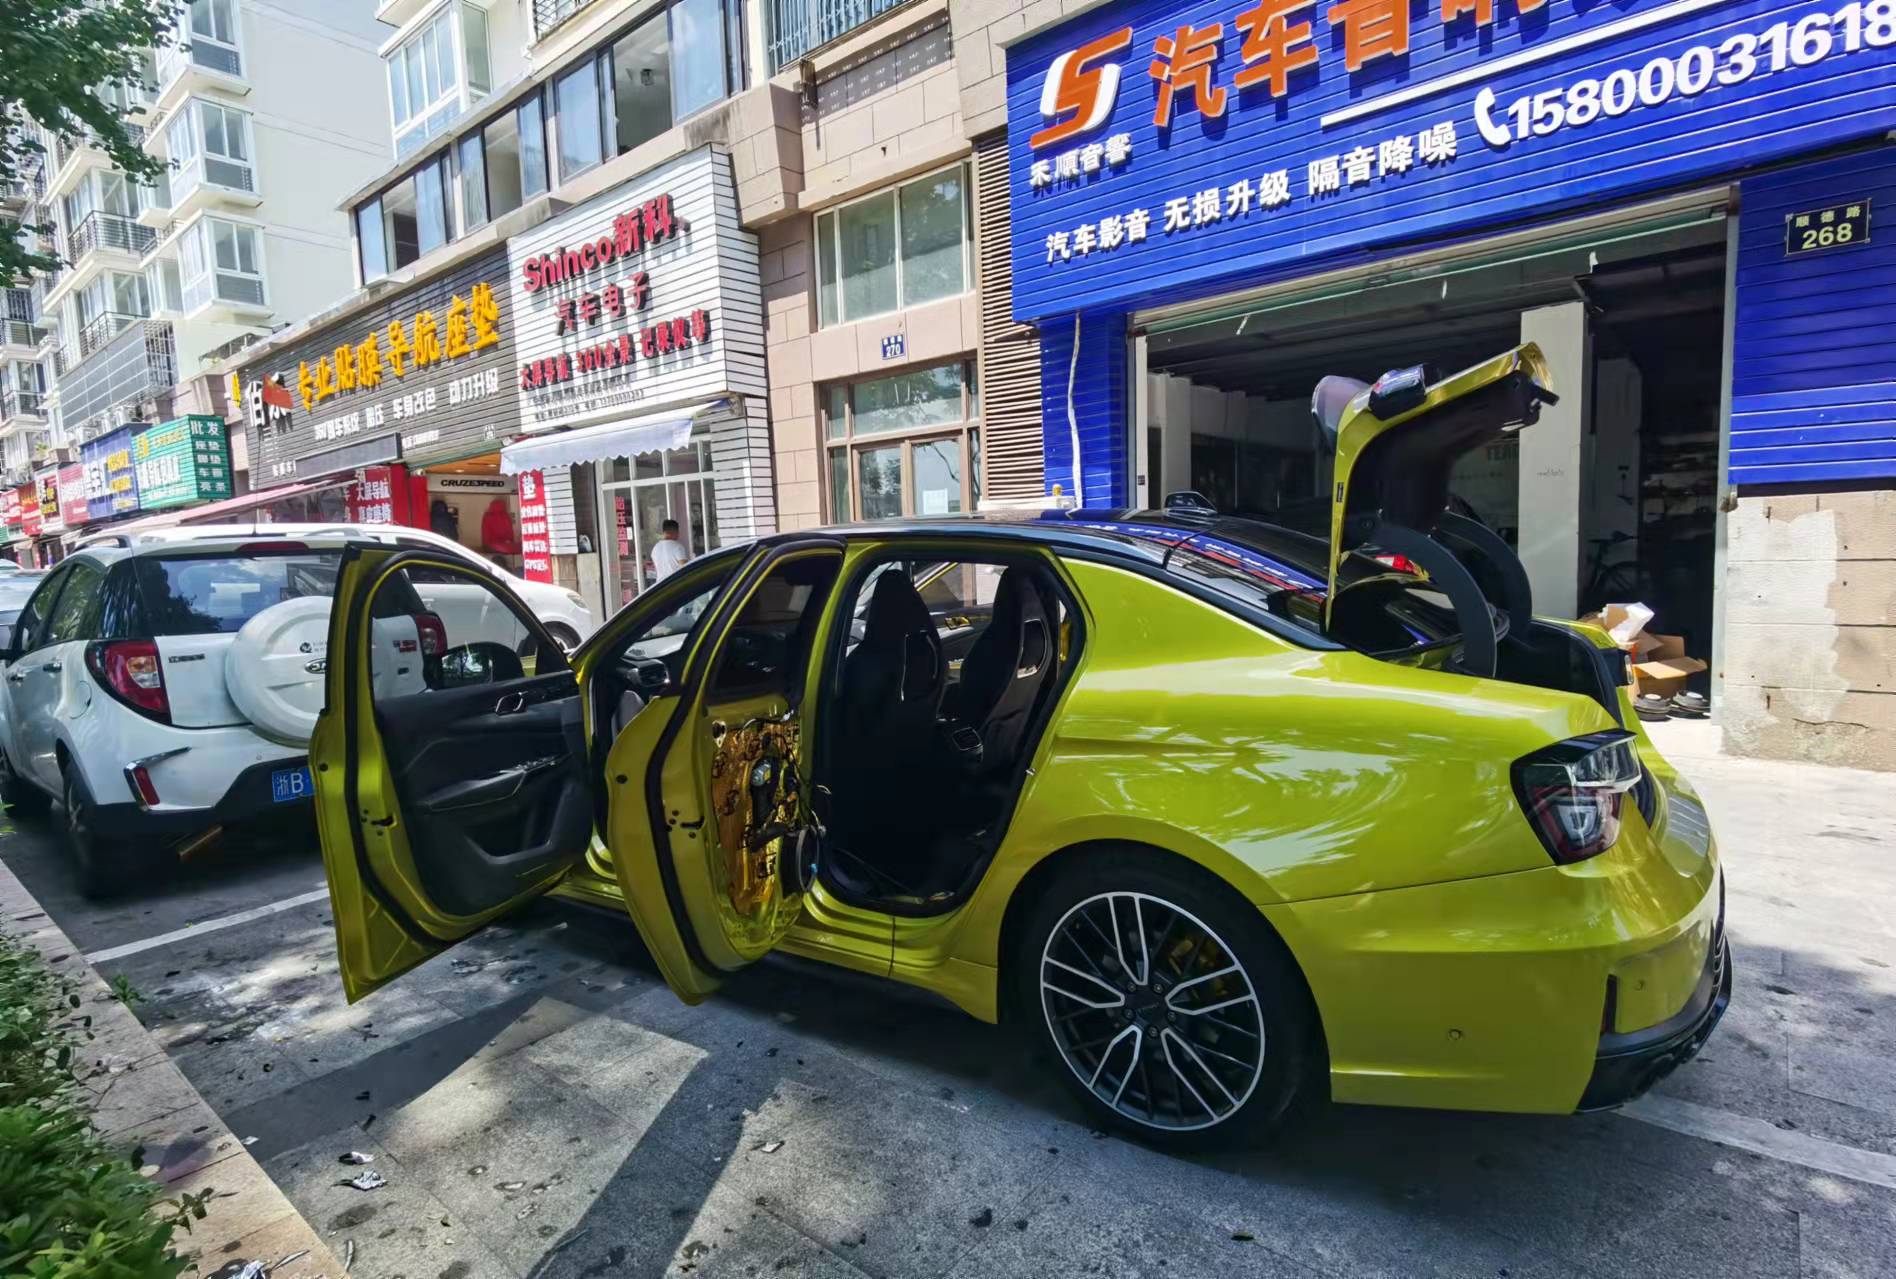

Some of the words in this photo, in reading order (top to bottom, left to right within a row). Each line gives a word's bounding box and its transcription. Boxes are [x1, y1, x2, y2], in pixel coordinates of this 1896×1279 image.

[1149, 0, 1555, 128] 汽车音
[1508, 1, 1896, 140] 15800031618
[1046, 208, 1150, 263] 汽车影音
[1164, 169, 1291, 233] 无损升级
[1308, 121, 1457, 195] 隔音降噪
[1802, 222, 1852, 249] 268
[190, 420, 219, 436] 批发
